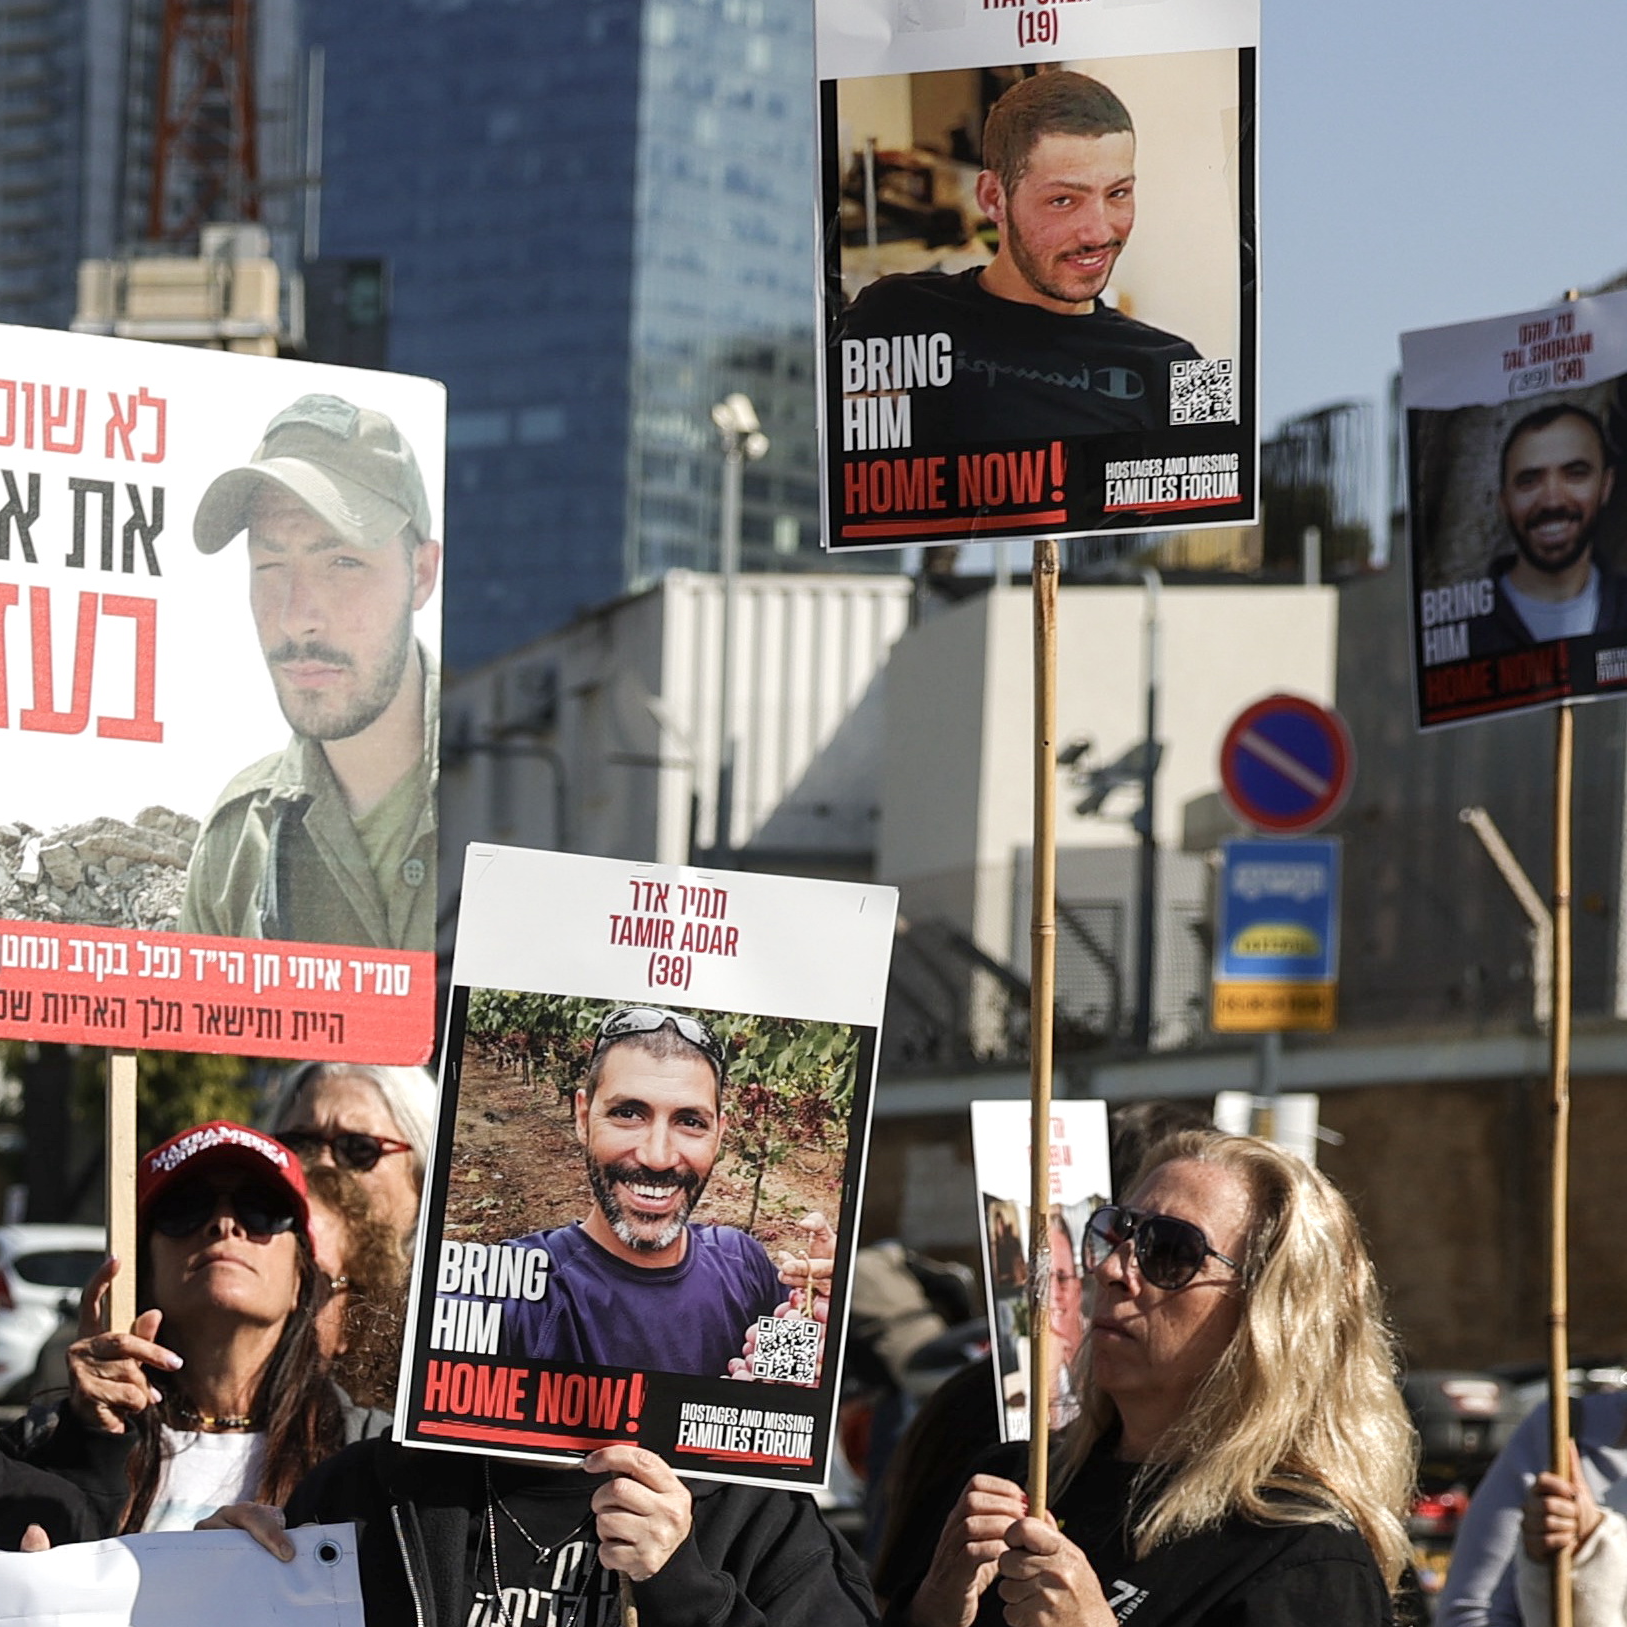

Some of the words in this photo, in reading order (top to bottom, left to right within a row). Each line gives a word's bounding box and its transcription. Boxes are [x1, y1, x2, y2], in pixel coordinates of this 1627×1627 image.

[1018, 8, 1058, 47] (19)
[841, 332, 953, 393] BRING
[104, 385, 168, 464] לא
[843, 394, 912, 450] HIM
[845, 457, 945, 514] HOME
[958, 441, 1065, 508] NOW!
[1105, 460, 1163, 479] HOSTAGES
[1164, 458, 1187, 476] AND
[1188, 453, 1238, 474] MISSING
[1105, 478, 1178, 506] FAMILIES
[1181, 473, 1238, 500] FORUM
[65, 476, 164, 576] את
[1421, 578, 1495, 628] BRING
[1424, 622, 1470, 667] HIM
[629, 880, 668, 914] אדר
[678, 884, 728, 921] תמיר
[609, 915, 675, 950] TAMIR
[680, 920, 739, 958] ADAR
[68, 941, 128, 976] בקרב
[136, 941, 181, 979] נפל
[254, 953, 280, 992] חן
[288, 954, 341, 988] איתי
[648, 954, 693, 990] (38)
[41, 990, 126, 1027] האריות
[135, 997, 181, 1038] מלך
[192, 999, 279, 1040] ותישאר
[290, 1009, 344, 1044] היית
[441, 1240, 548, 1301] BRING
[430, 1298, 502, 1355] HIM
[424, 1360, 528, 1420] HOME
[537, 1369, 644, 1432] NOW!
[681, 1402, 738, 1426] HOSTAGES
[740, 1408, 763, 1428] AND
[764, 1410, 813, 1434] MISSING
[679, 1421, 751, 1453] FAMILIES
[754, 1428, 812, 1459] FORUM
